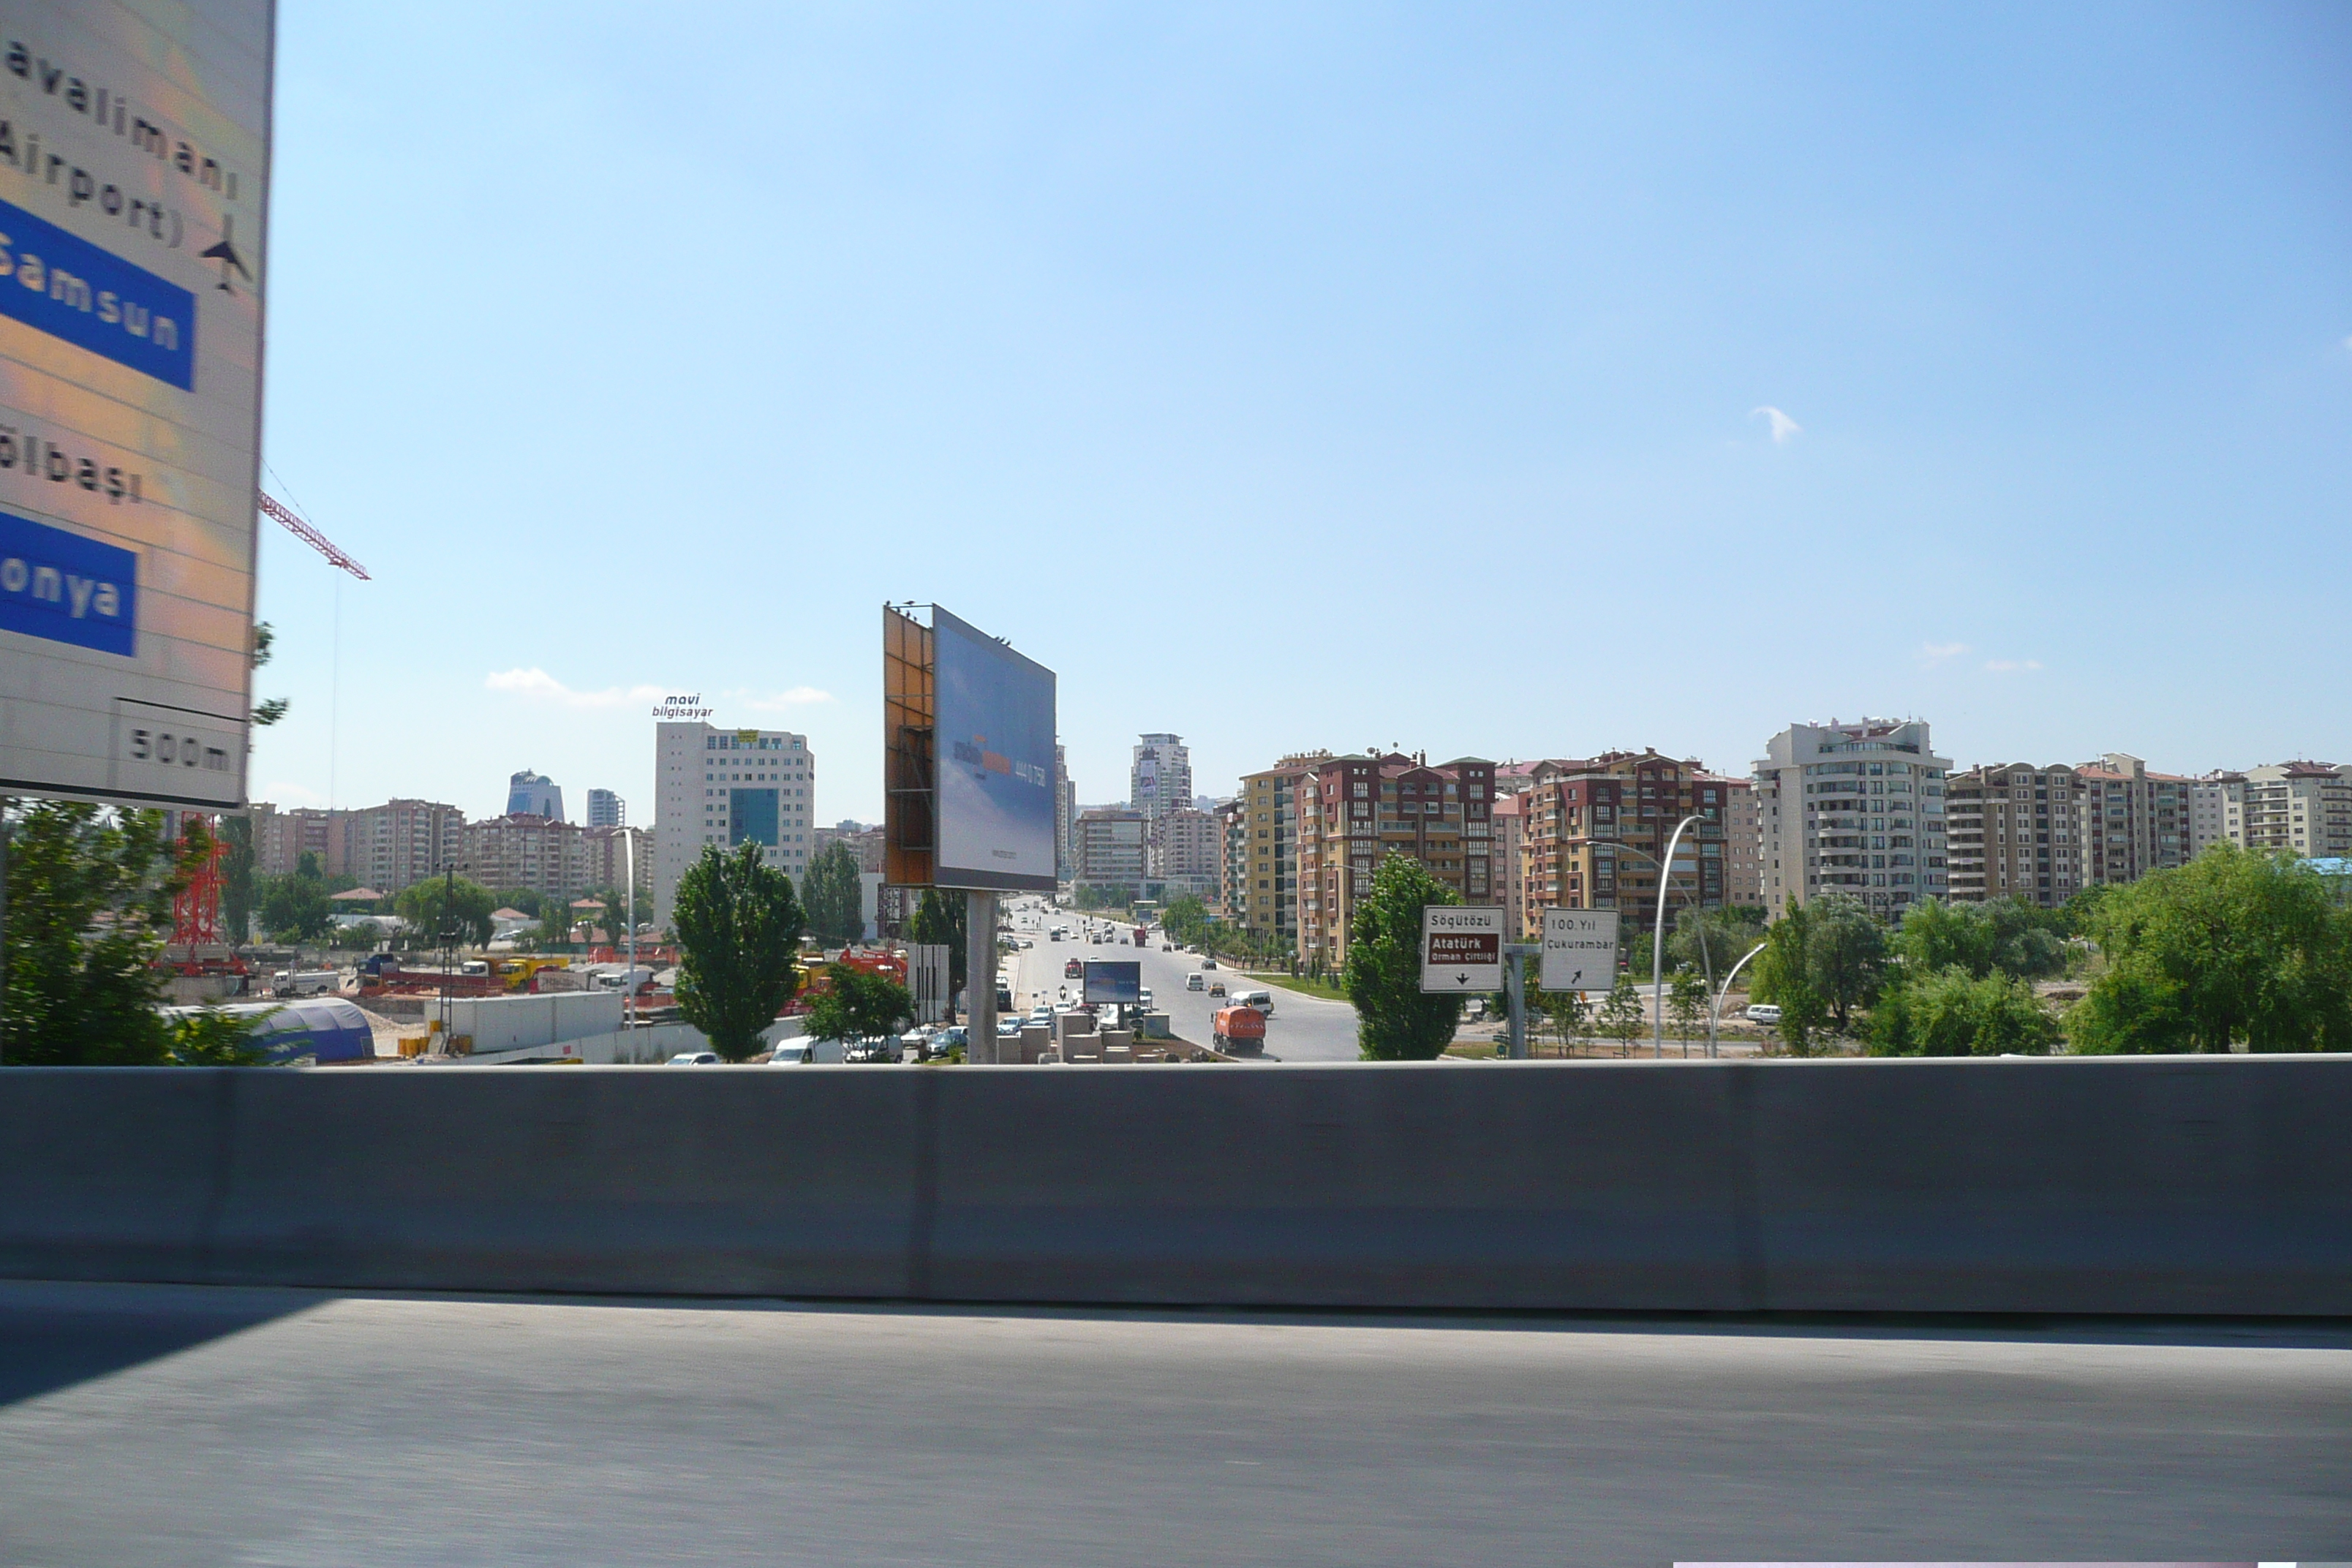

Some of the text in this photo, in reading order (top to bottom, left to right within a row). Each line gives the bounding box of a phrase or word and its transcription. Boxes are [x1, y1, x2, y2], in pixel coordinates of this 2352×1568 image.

[1, 557, 121, 619] onya
[665, 693, 701, 705] mavi
[652, 706, 714, 720] bilgisayar
[1432, 938, 1482, 949] Atatürk
[1548, 939, 1614, 950] Çukurambar
[1432, 952, 1461, 961] Orman
